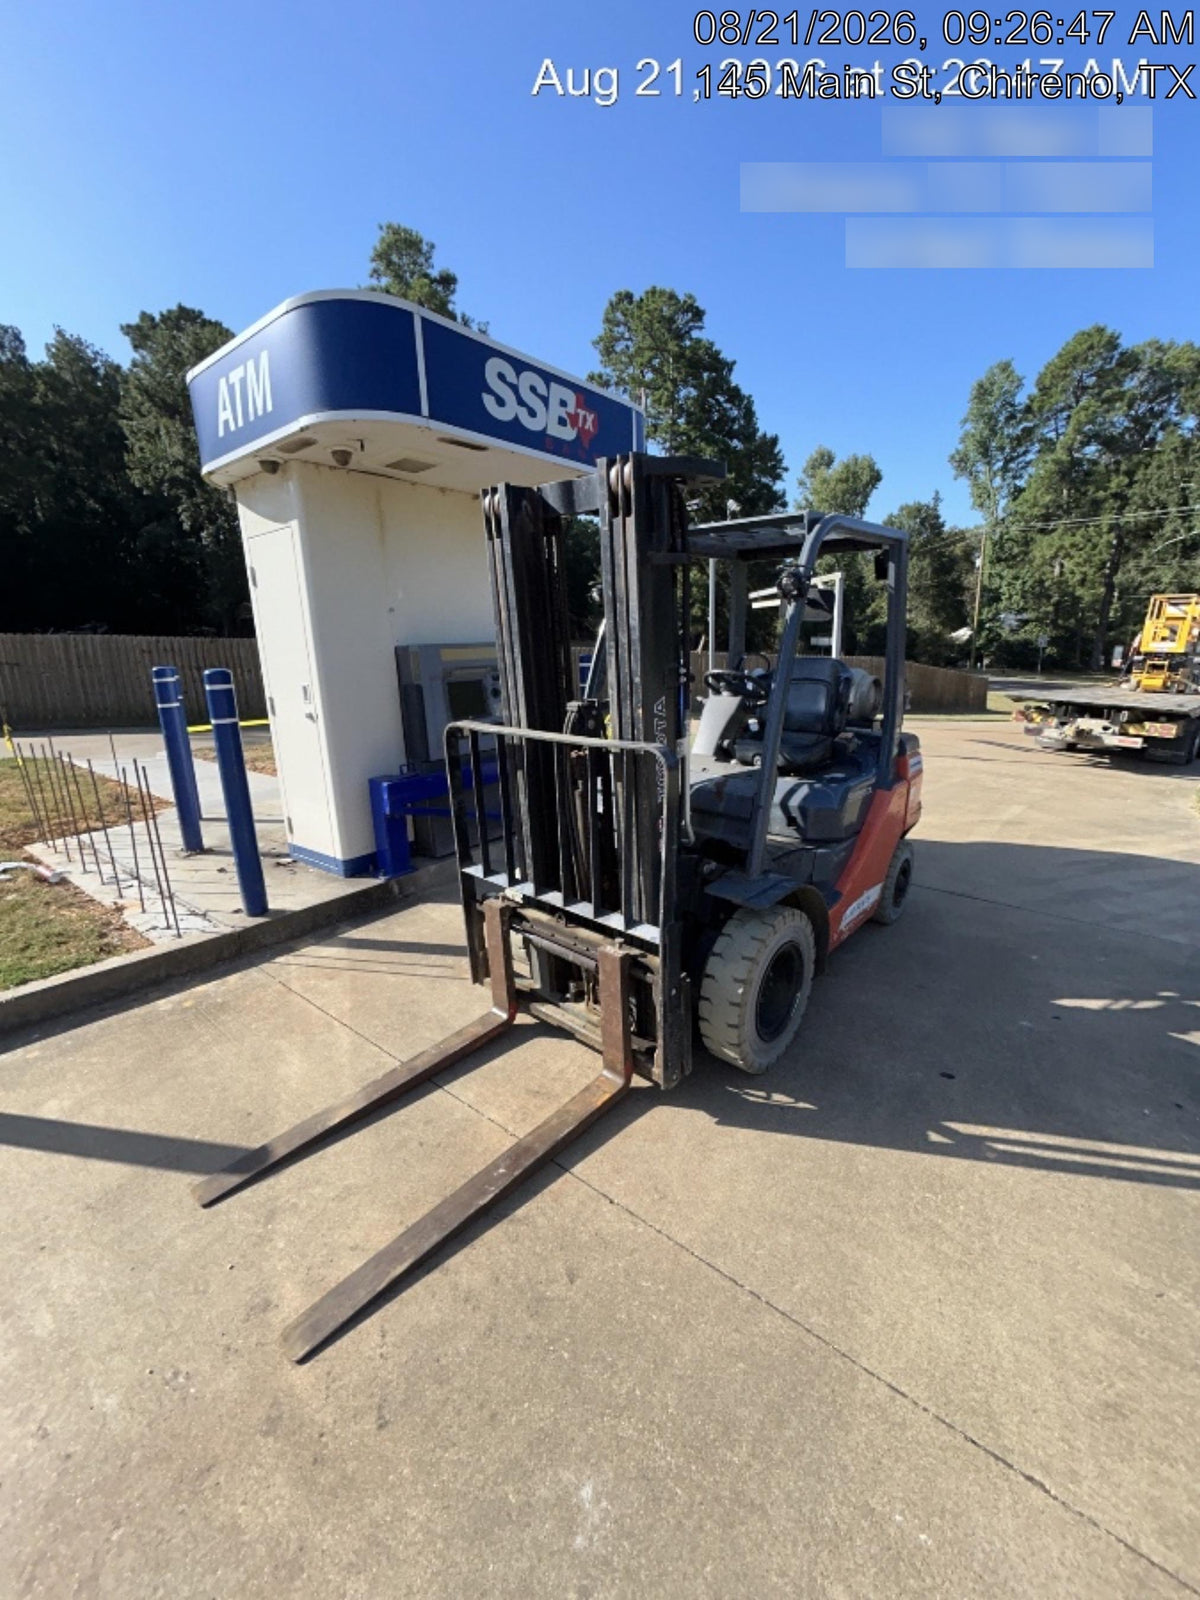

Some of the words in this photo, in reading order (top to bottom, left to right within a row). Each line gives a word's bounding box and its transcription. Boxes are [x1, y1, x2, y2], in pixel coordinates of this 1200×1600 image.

[217, 350, 274, 437] ATM
[481, 357, 578, 441] SSB
[577, 408, 596, 433] TX
